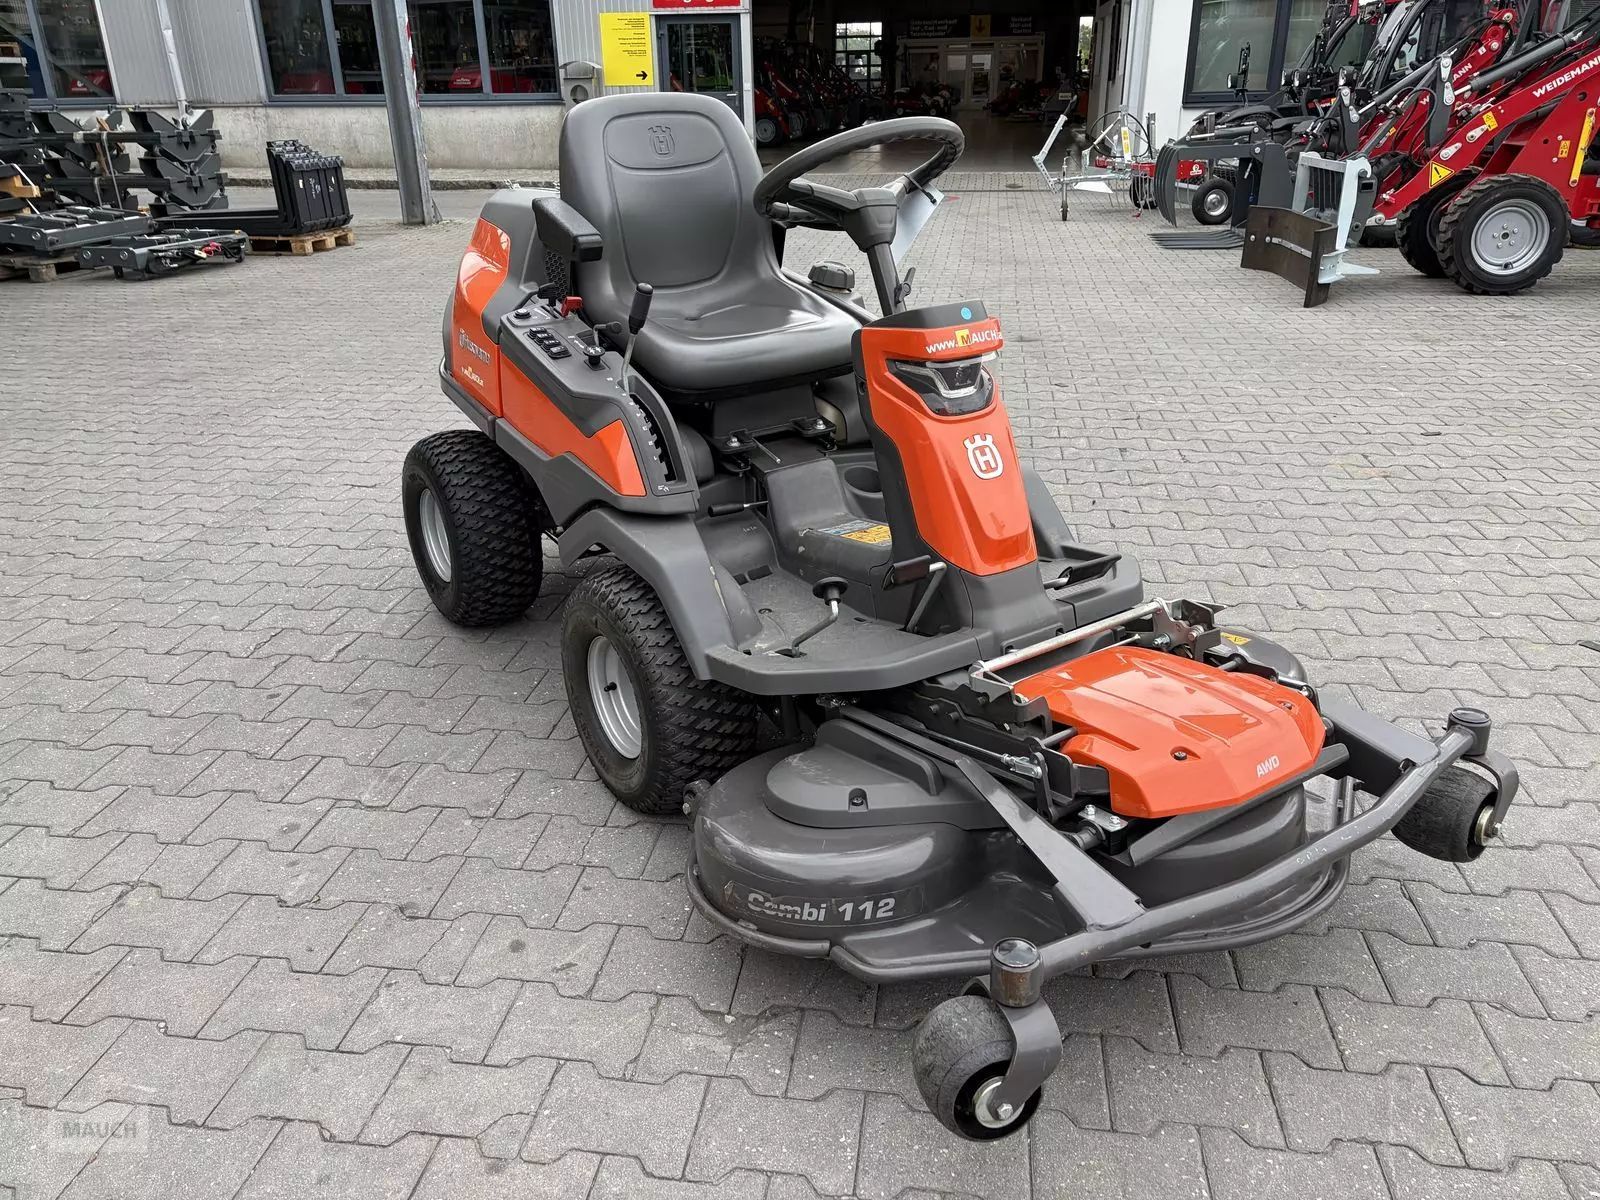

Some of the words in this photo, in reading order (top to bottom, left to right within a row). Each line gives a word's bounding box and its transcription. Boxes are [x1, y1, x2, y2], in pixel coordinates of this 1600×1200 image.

[1532, 55, 1600, 98] WEIDEMAN
[1255, 755, 1280, 778] AWD
[747, 892, 827, 922] Combi
[838, 897, 896, 922] 112
